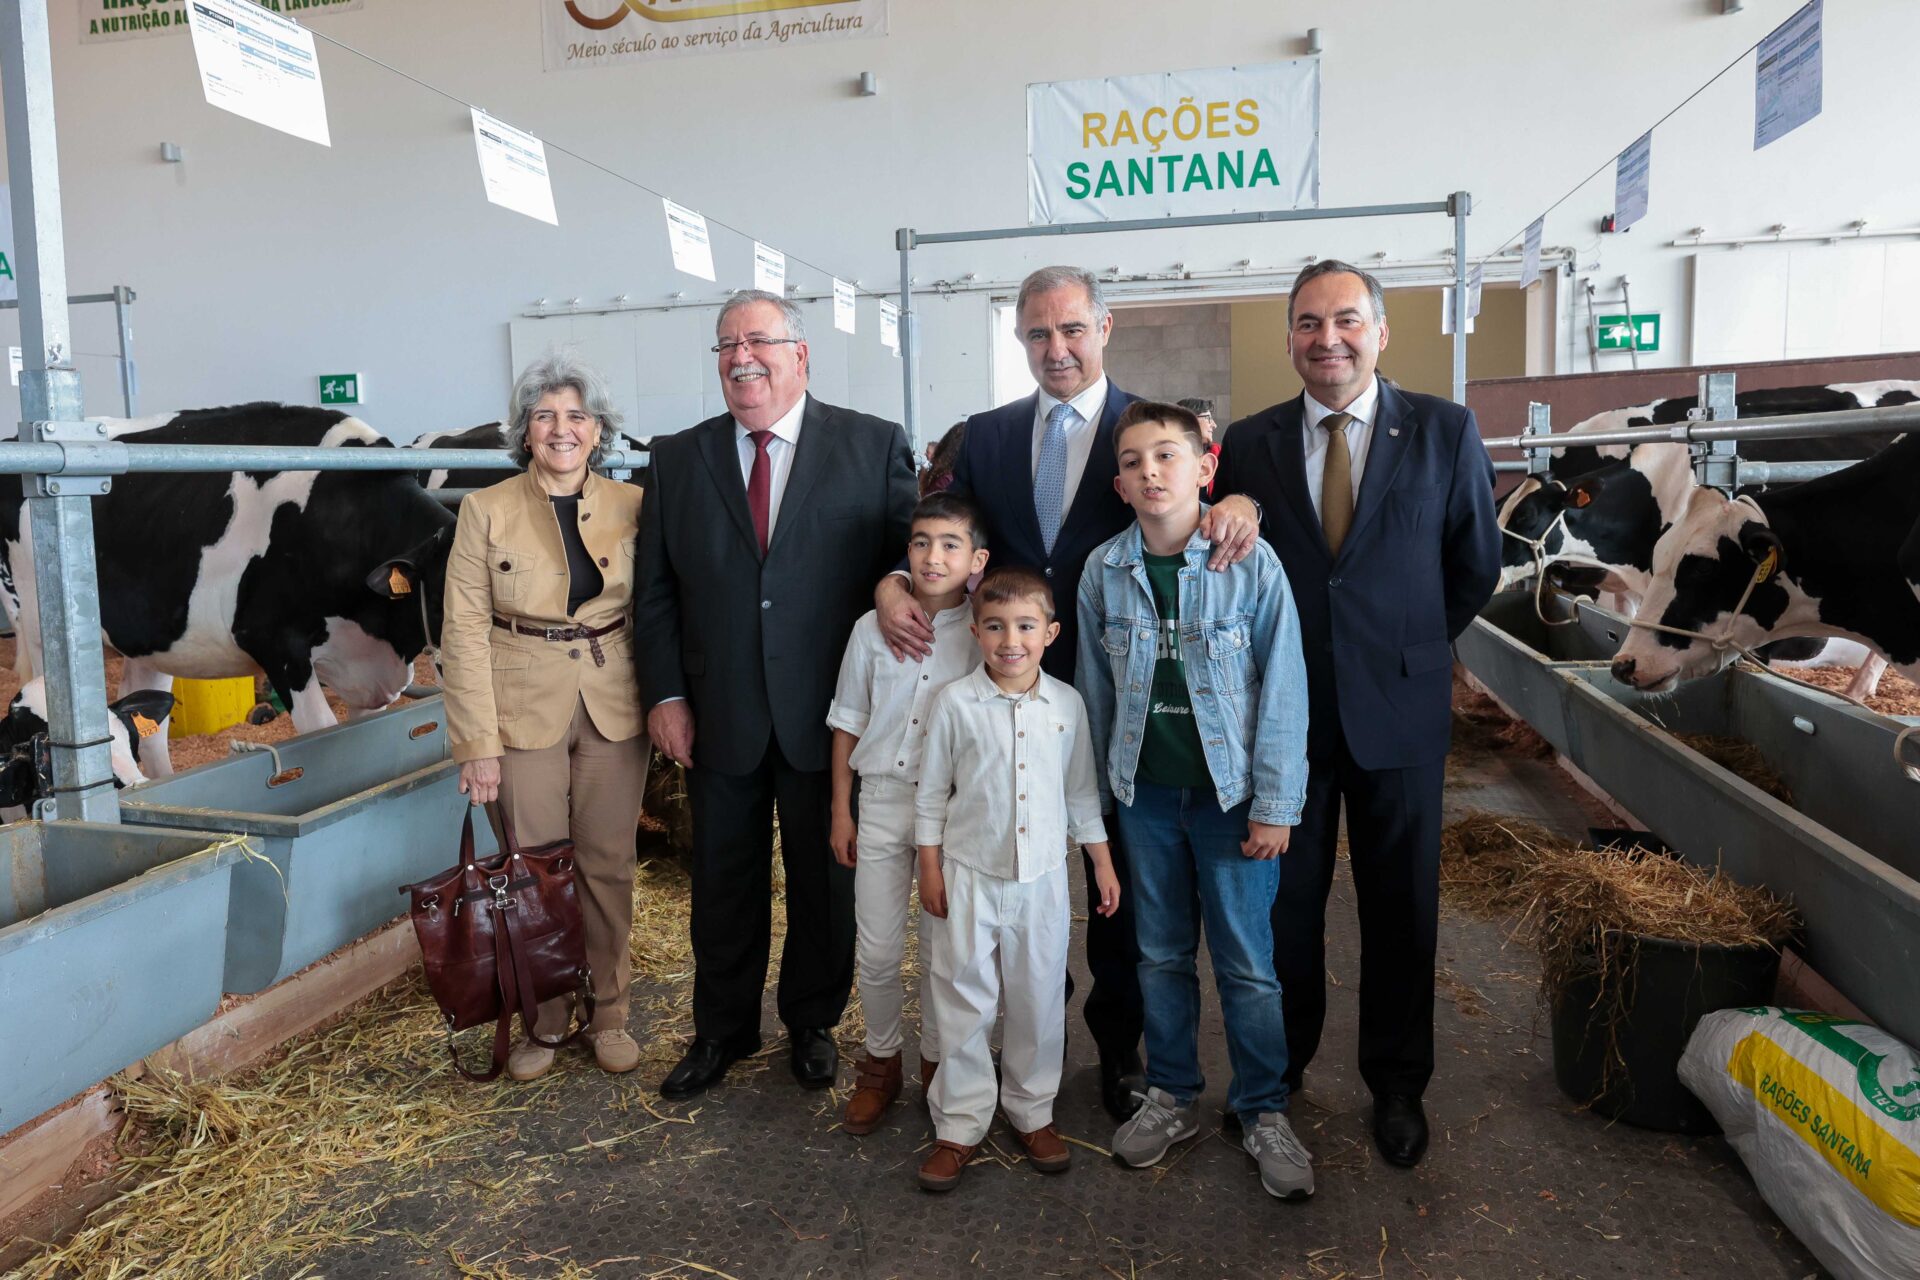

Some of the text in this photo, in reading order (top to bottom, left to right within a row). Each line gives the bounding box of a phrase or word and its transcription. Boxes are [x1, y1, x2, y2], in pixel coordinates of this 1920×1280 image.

[90, 19, 99, 34] A
[101, 9, 170, 33] NUTRIÇÃO
[567, 12, 863, 60] Meio século ao serviço da Agricultura
[1082, 97, 1261, 153] RAÇÕES
[1065, 148, 1281, 200] SANTANA
[1152, 702, 1190, 715] Leisure
[1759, 1073, 1873, 1180] RAÇÕES SANTANA
